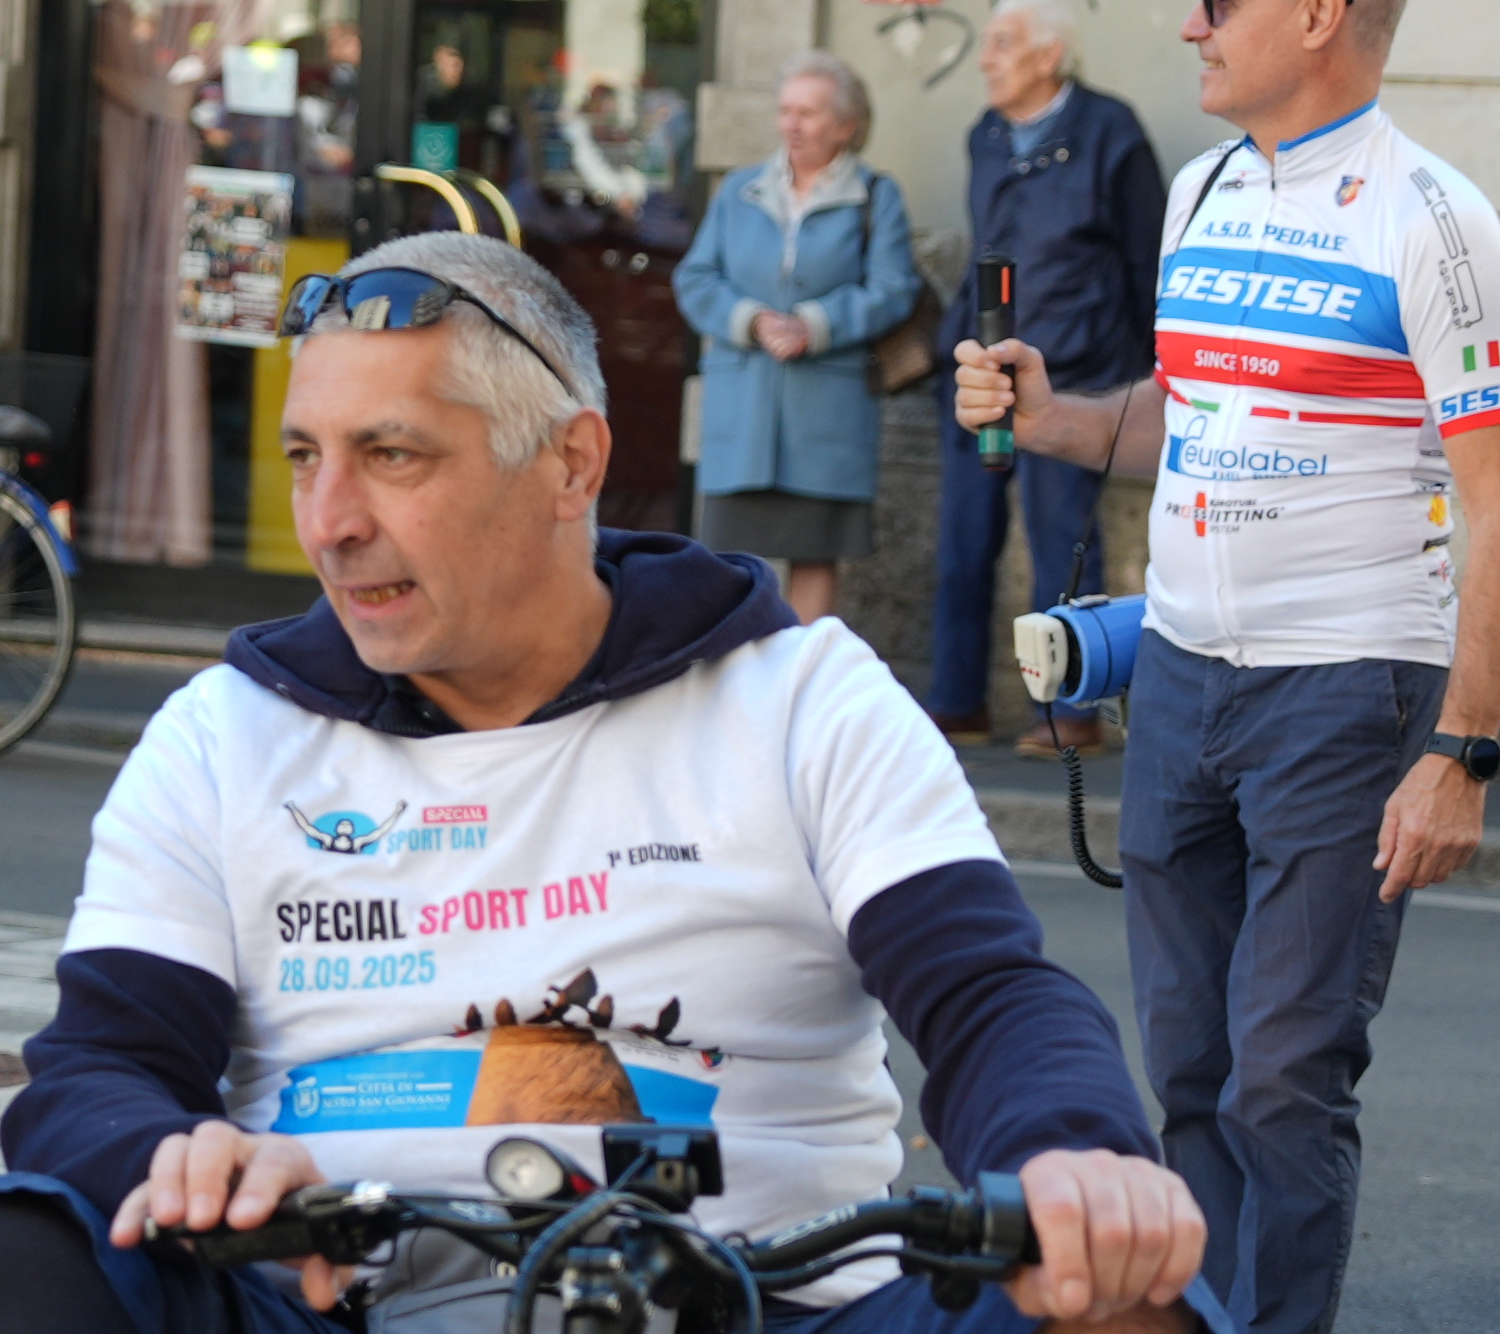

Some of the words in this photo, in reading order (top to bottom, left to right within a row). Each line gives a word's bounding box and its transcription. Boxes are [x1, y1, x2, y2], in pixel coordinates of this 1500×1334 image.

[1201, 221, 1253, 239] A.S.D.
[1262, 223, 1350, 253] PEDALE
[1161, 264, 1364, 323] SESTESE
[1194, 348, 1237, 372] SINCE
[1241, 354, 1281, 377] 1950
[1184, 446, 1328, 479] eurolabel
[424, 807, 485, 823] SPECIAL
[386, 827, 444, 854] SPORT
[450, 824, 489, 850] DAY
[629, 842, 703, 866] EDIZIONE
[277, 899, 408, 944] SPECIAL
[418, 887, 530, 936] SPORT
[542, 870, 610, 921] DAY
[278, 949, 437, 994] 28.09.2025
